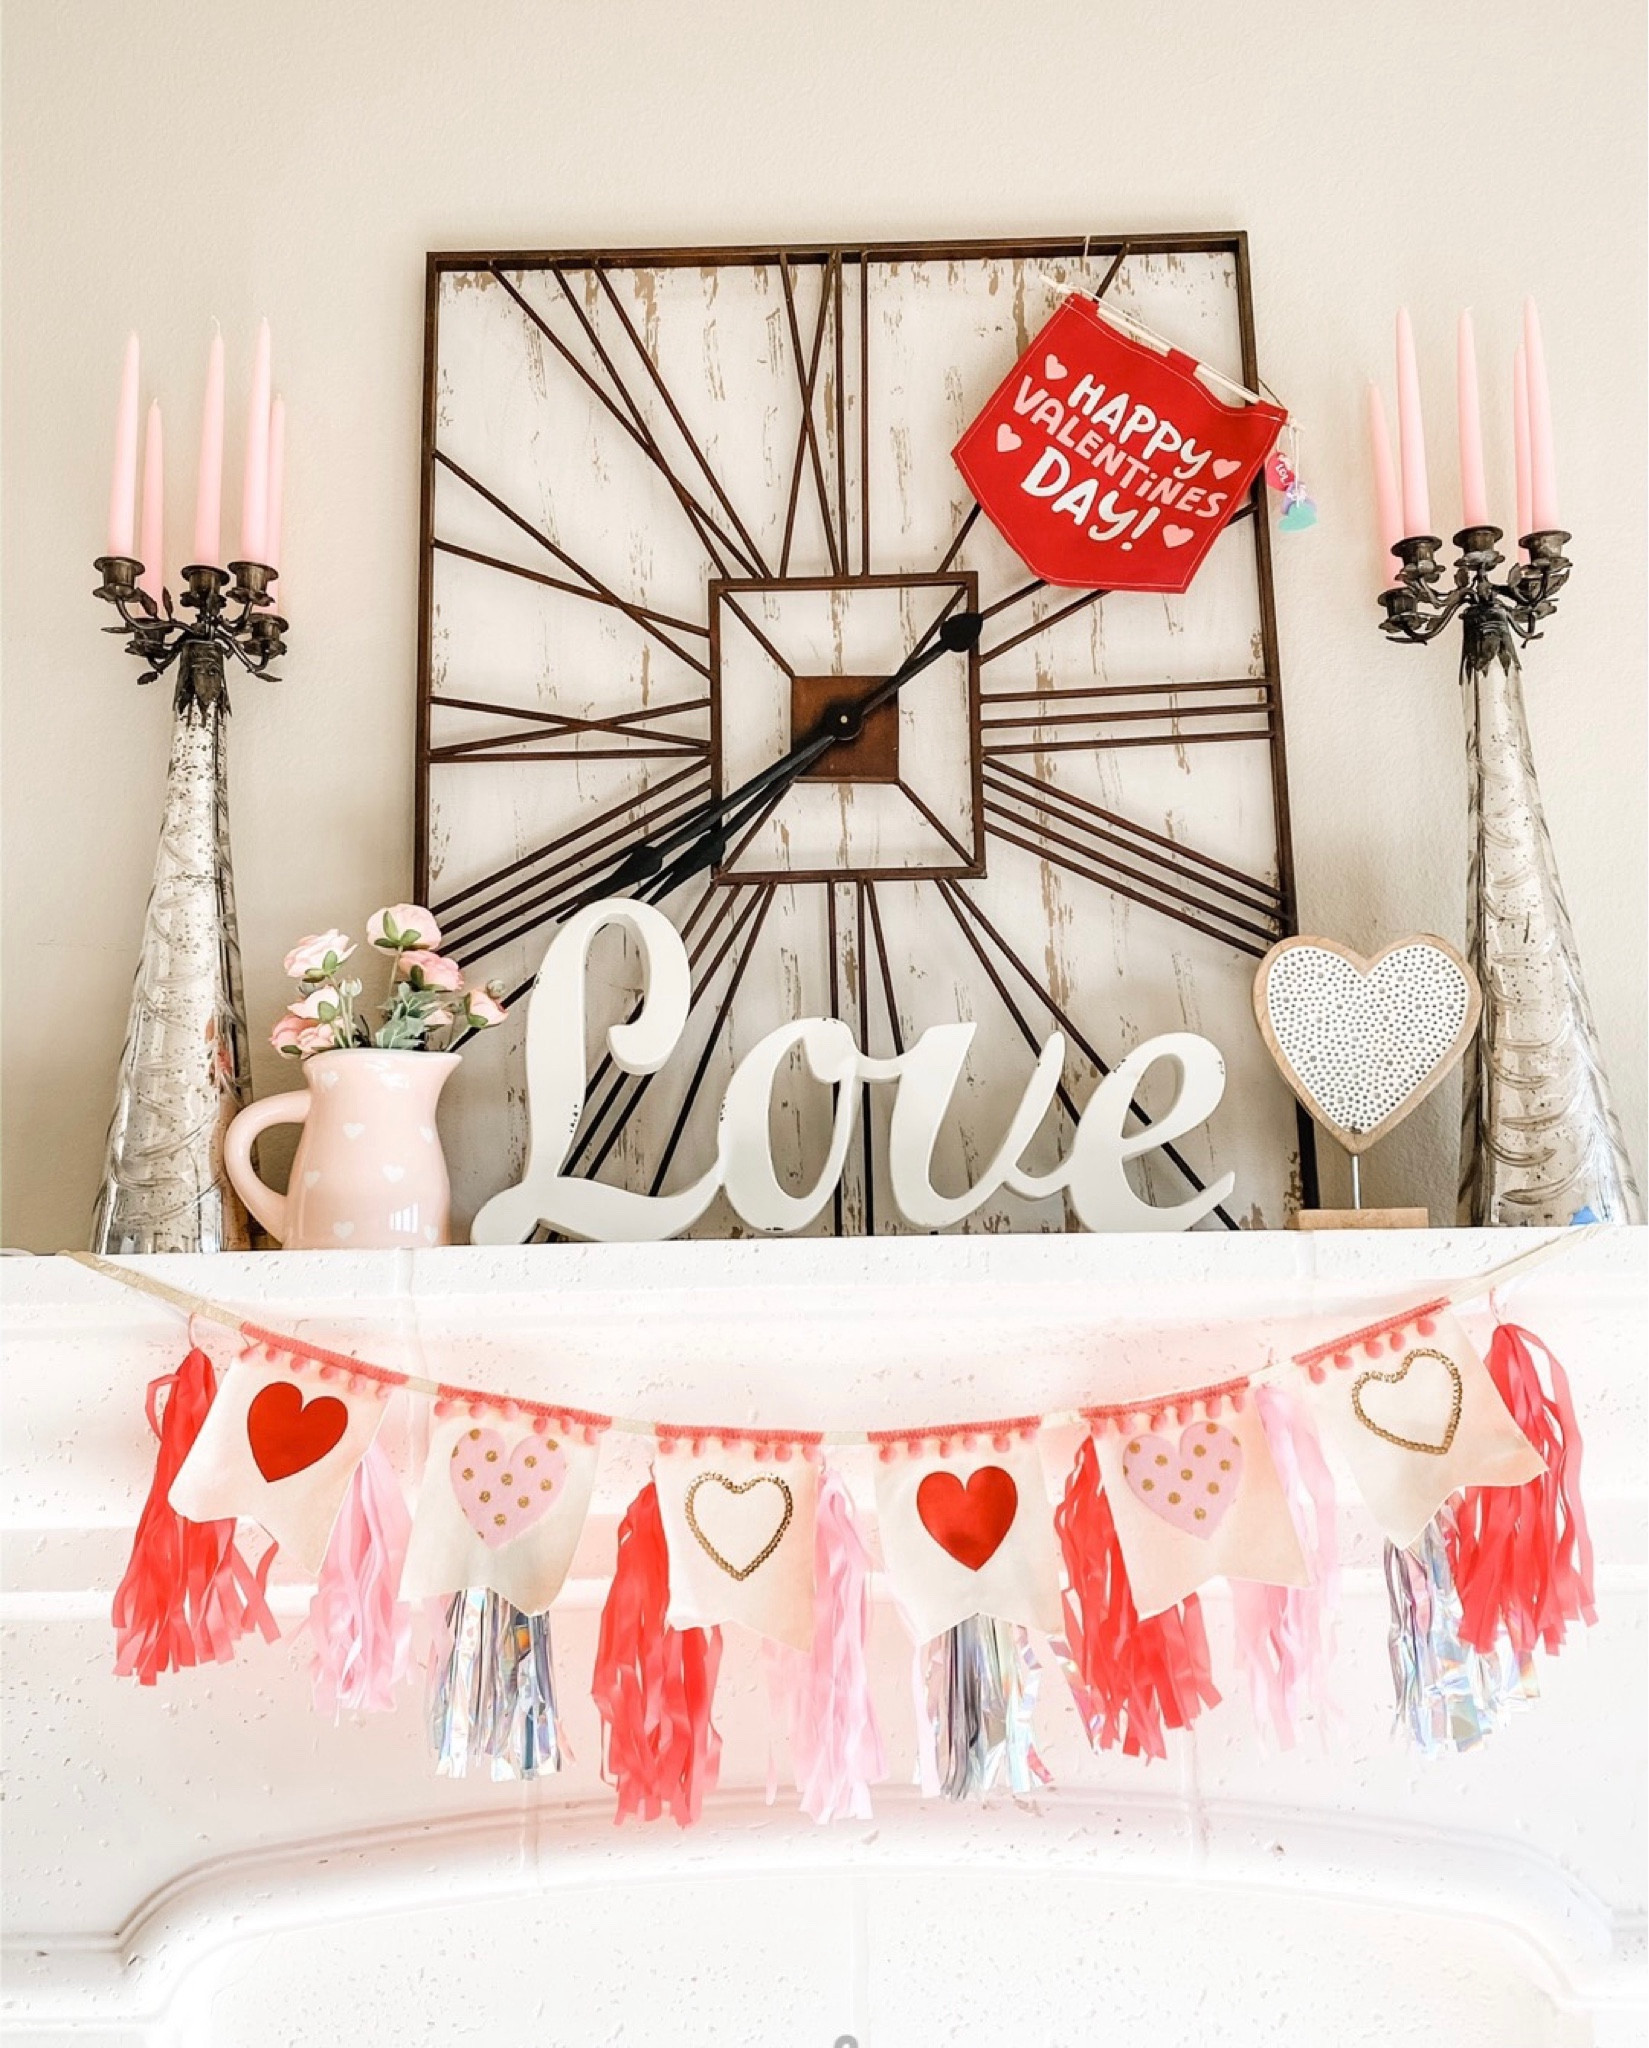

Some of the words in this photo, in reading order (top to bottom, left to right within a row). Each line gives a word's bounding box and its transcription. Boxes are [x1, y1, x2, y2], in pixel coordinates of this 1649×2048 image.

[1068, 373, 1213, 480] HAPPY
[1020, 445, 1161, 552] DAY!
[470, 896, 1236, 1246] Love
